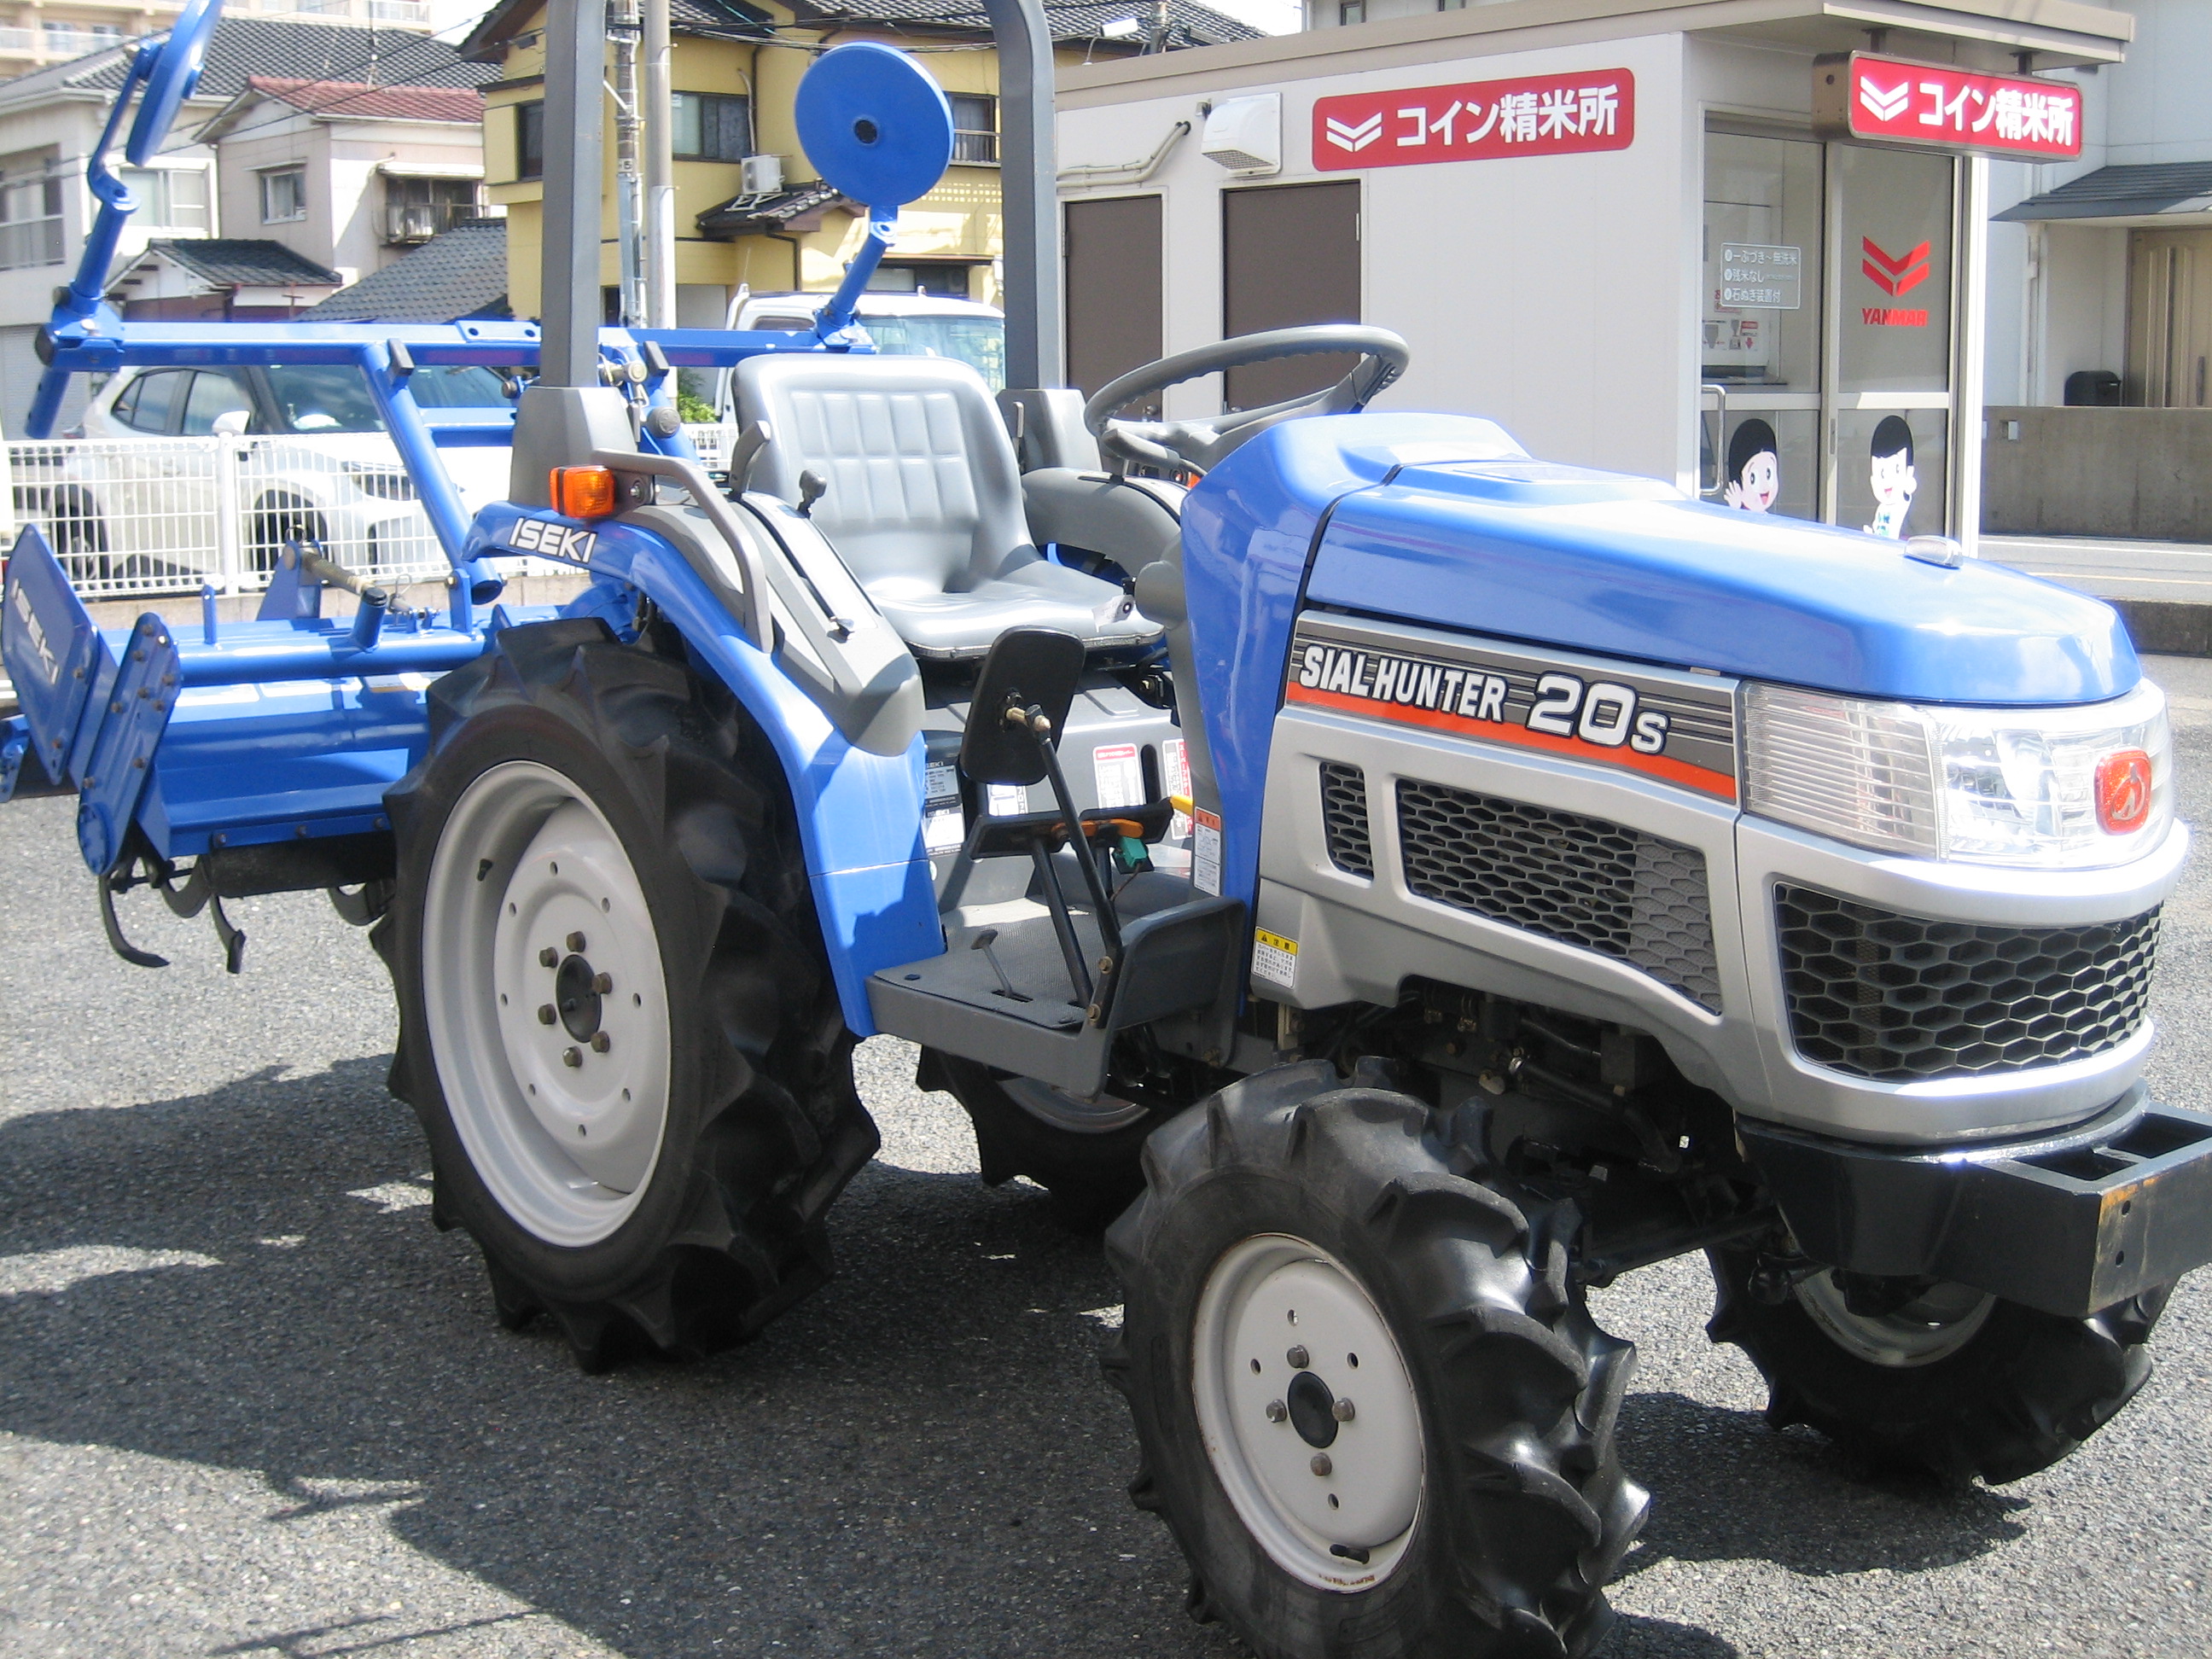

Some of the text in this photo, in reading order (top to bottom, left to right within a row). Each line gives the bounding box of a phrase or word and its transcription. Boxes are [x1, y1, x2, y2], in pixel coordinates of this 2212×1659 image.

[1396, 84, 1619, 147] コイン精米所
[1918, 82, 2074, 146] コイン精米所
[1862, 307, 1928, 327] YANMAR
[509, 516, 597, 563] ISEKI
[1300, 645, 1370, 697] SIAL
[1372, 657, 1507, 723] HUNTER
